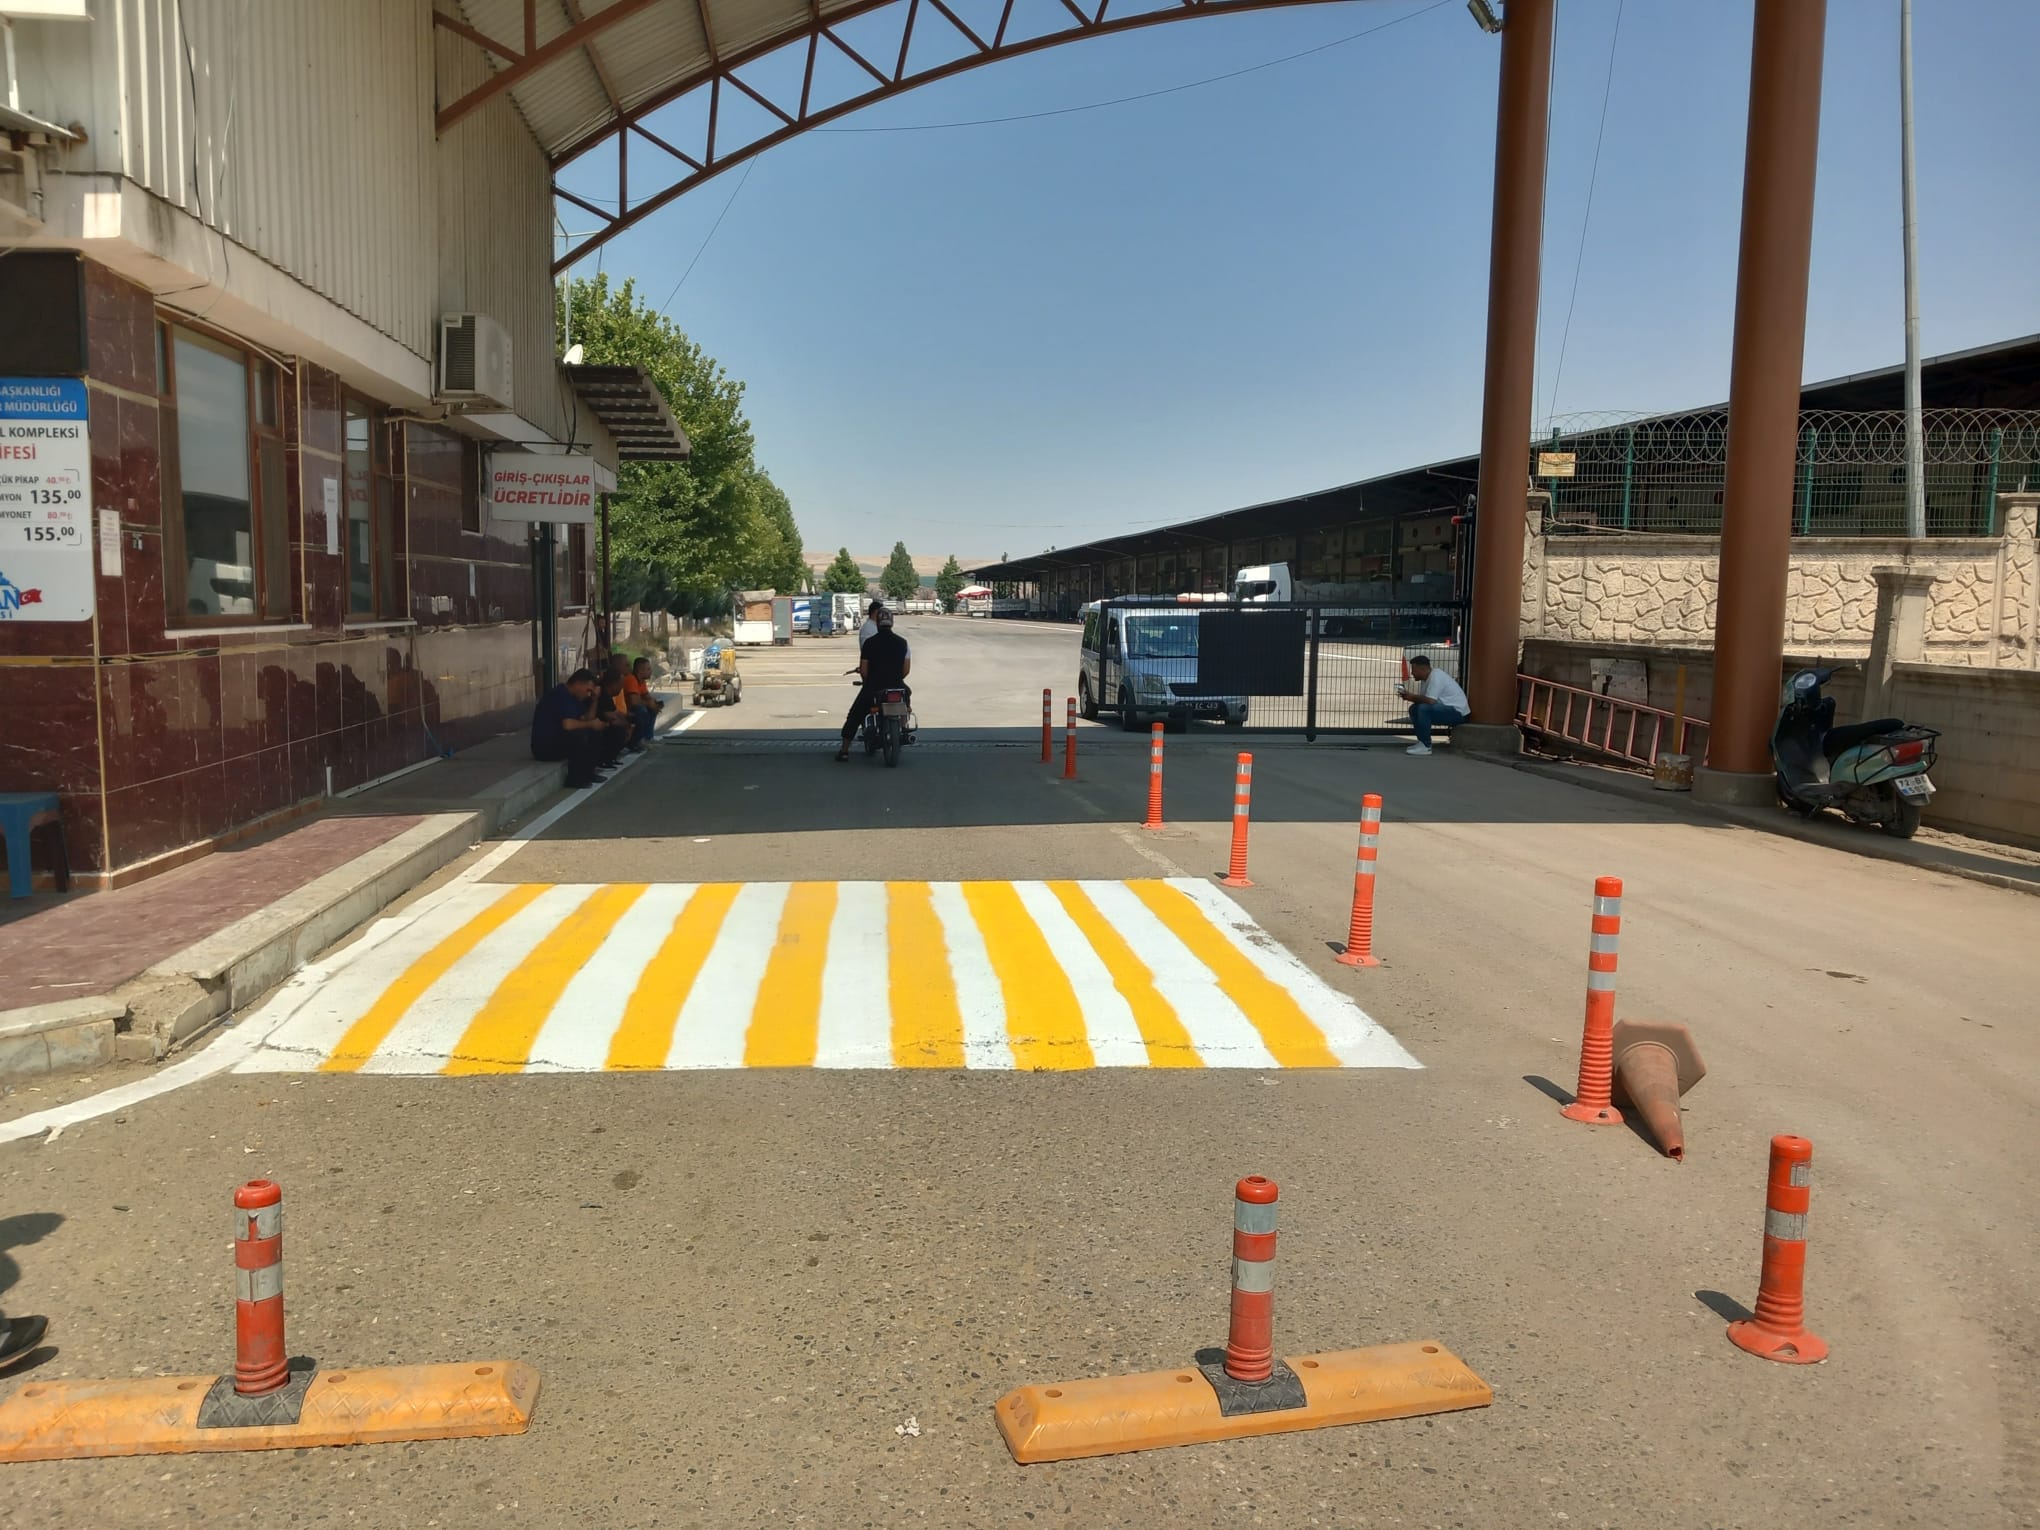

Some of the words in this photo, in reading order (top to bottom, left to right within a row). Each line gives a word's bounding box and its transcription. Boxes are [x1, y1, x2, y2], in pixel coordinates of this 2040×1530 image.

[0, 384, 61, 399] AŞKANLIĞI
[4, 399, 78, 413] MÜDÜRLÜĞÜ
[8, 425, 79, 439] KOMPLEKSİ
[0, 473, 13, 484] ÜK
[14, 474, 39, 484] PİKAP
[494, 469, 590, 486] GİRİŞ-ÇIKIŞLAR
[30, 489, 81, 504] 135.00
[494, 487, 591, 506] ÜCRETLİDİR
[23, 526, 74, 541] 155.00
